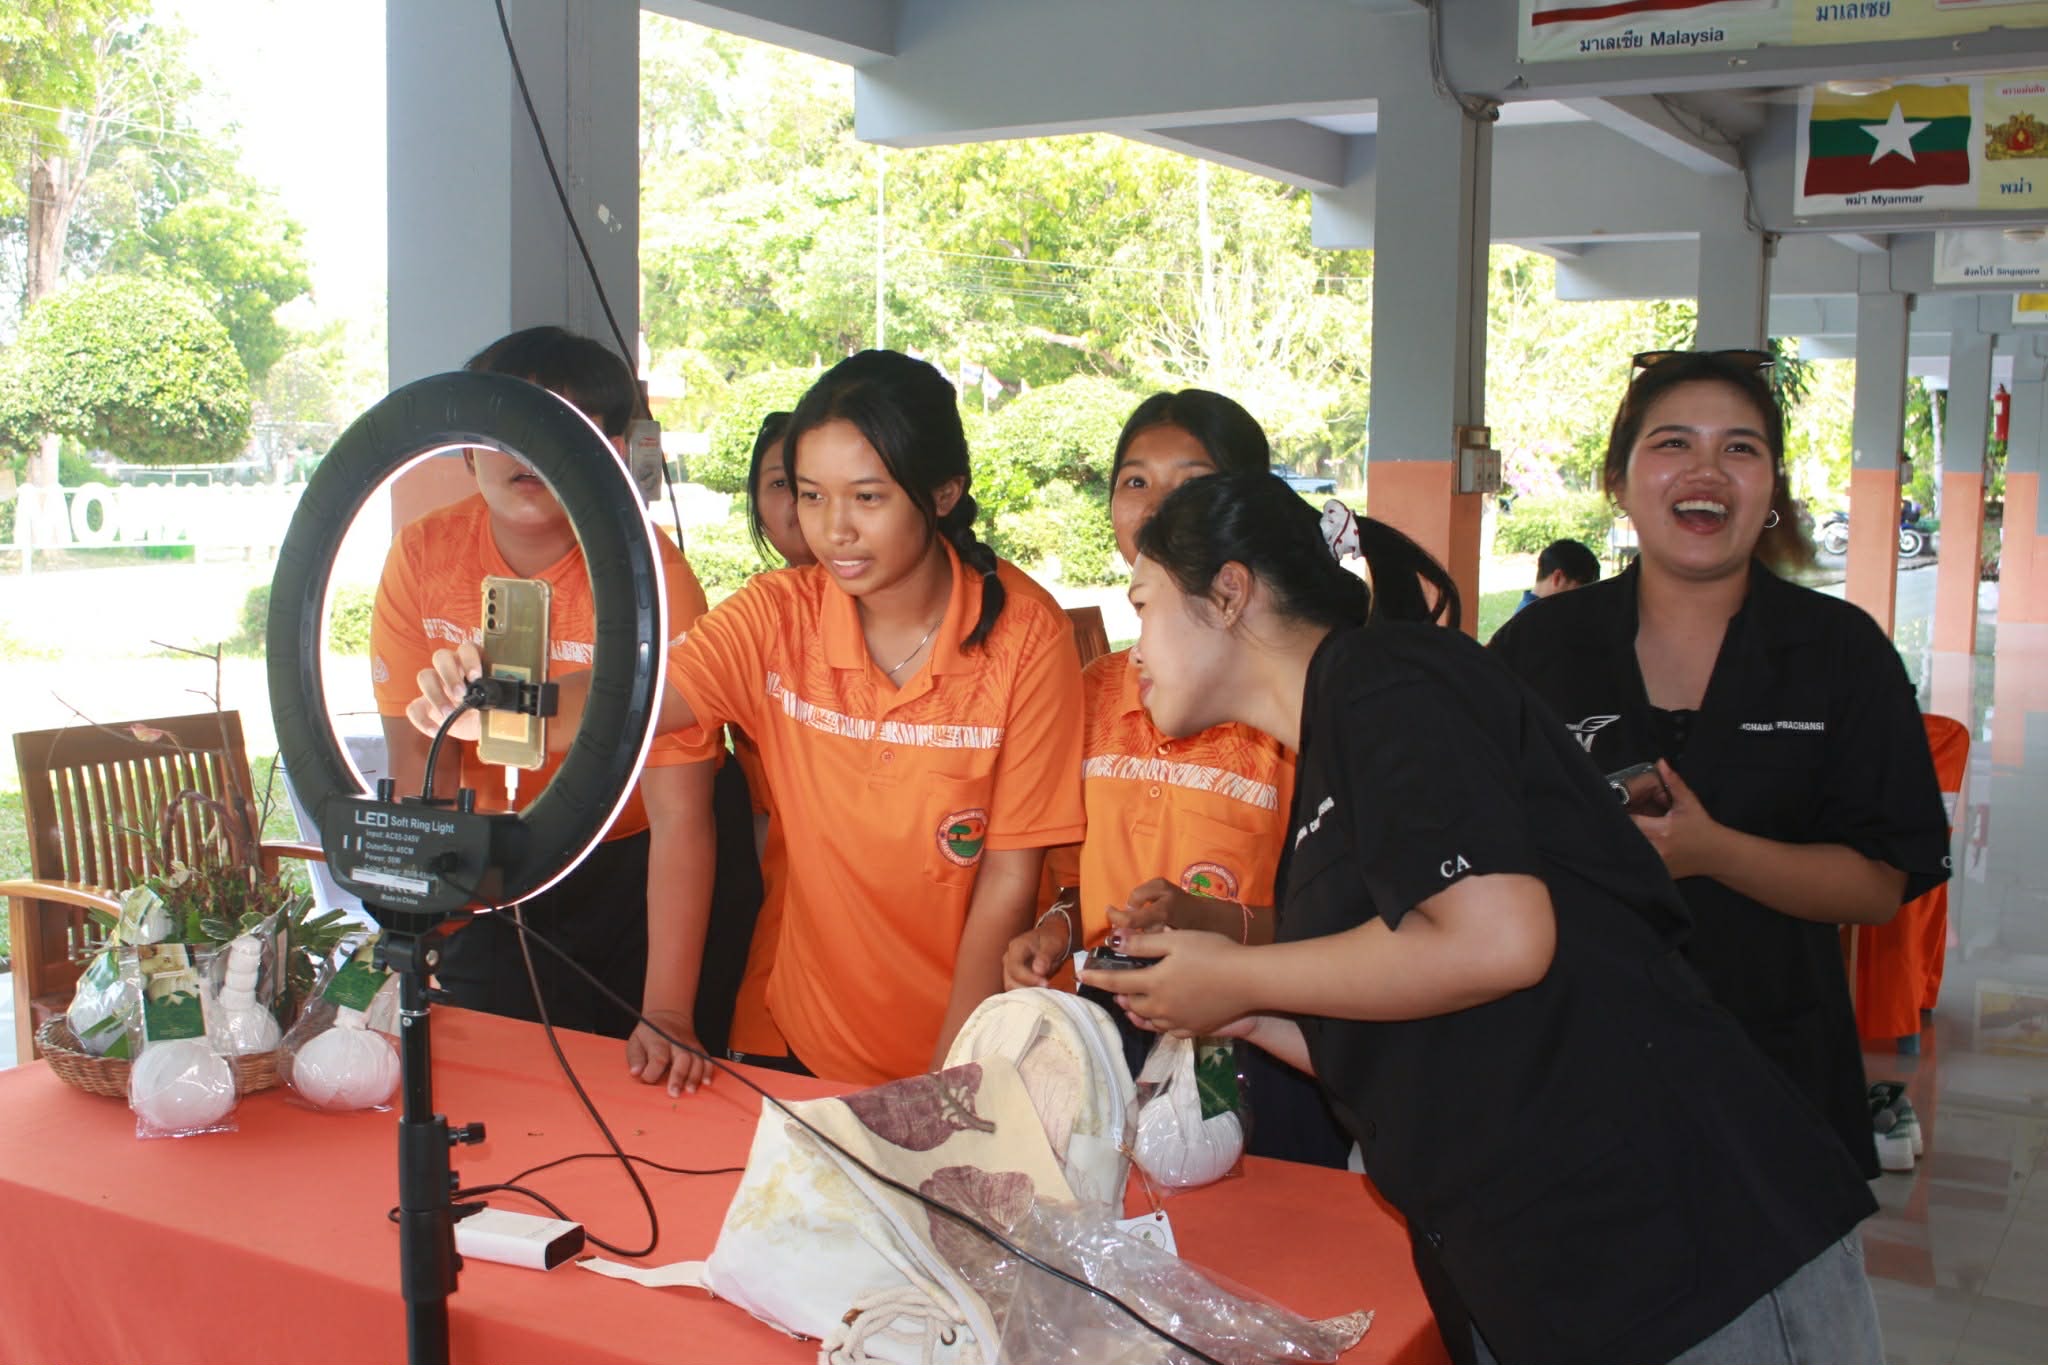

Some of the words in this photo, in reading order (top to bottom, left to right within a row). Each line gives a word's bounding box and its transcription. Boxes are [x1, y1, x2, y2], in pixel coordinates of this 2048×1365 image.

[1580, 29, 1643, 52] มาเลเซีย
[1650, 26, 1725, 47] Malaysia
[1999, 177, 2033, 194] พม่า
[1871, 194, 1924, 207] Myanmar
[355, 810, 388, 827] LED
[391, 815, 409, 828] Soft
[410, 817, 431, 833] Ring
[432, 821, 455, 834] Light
